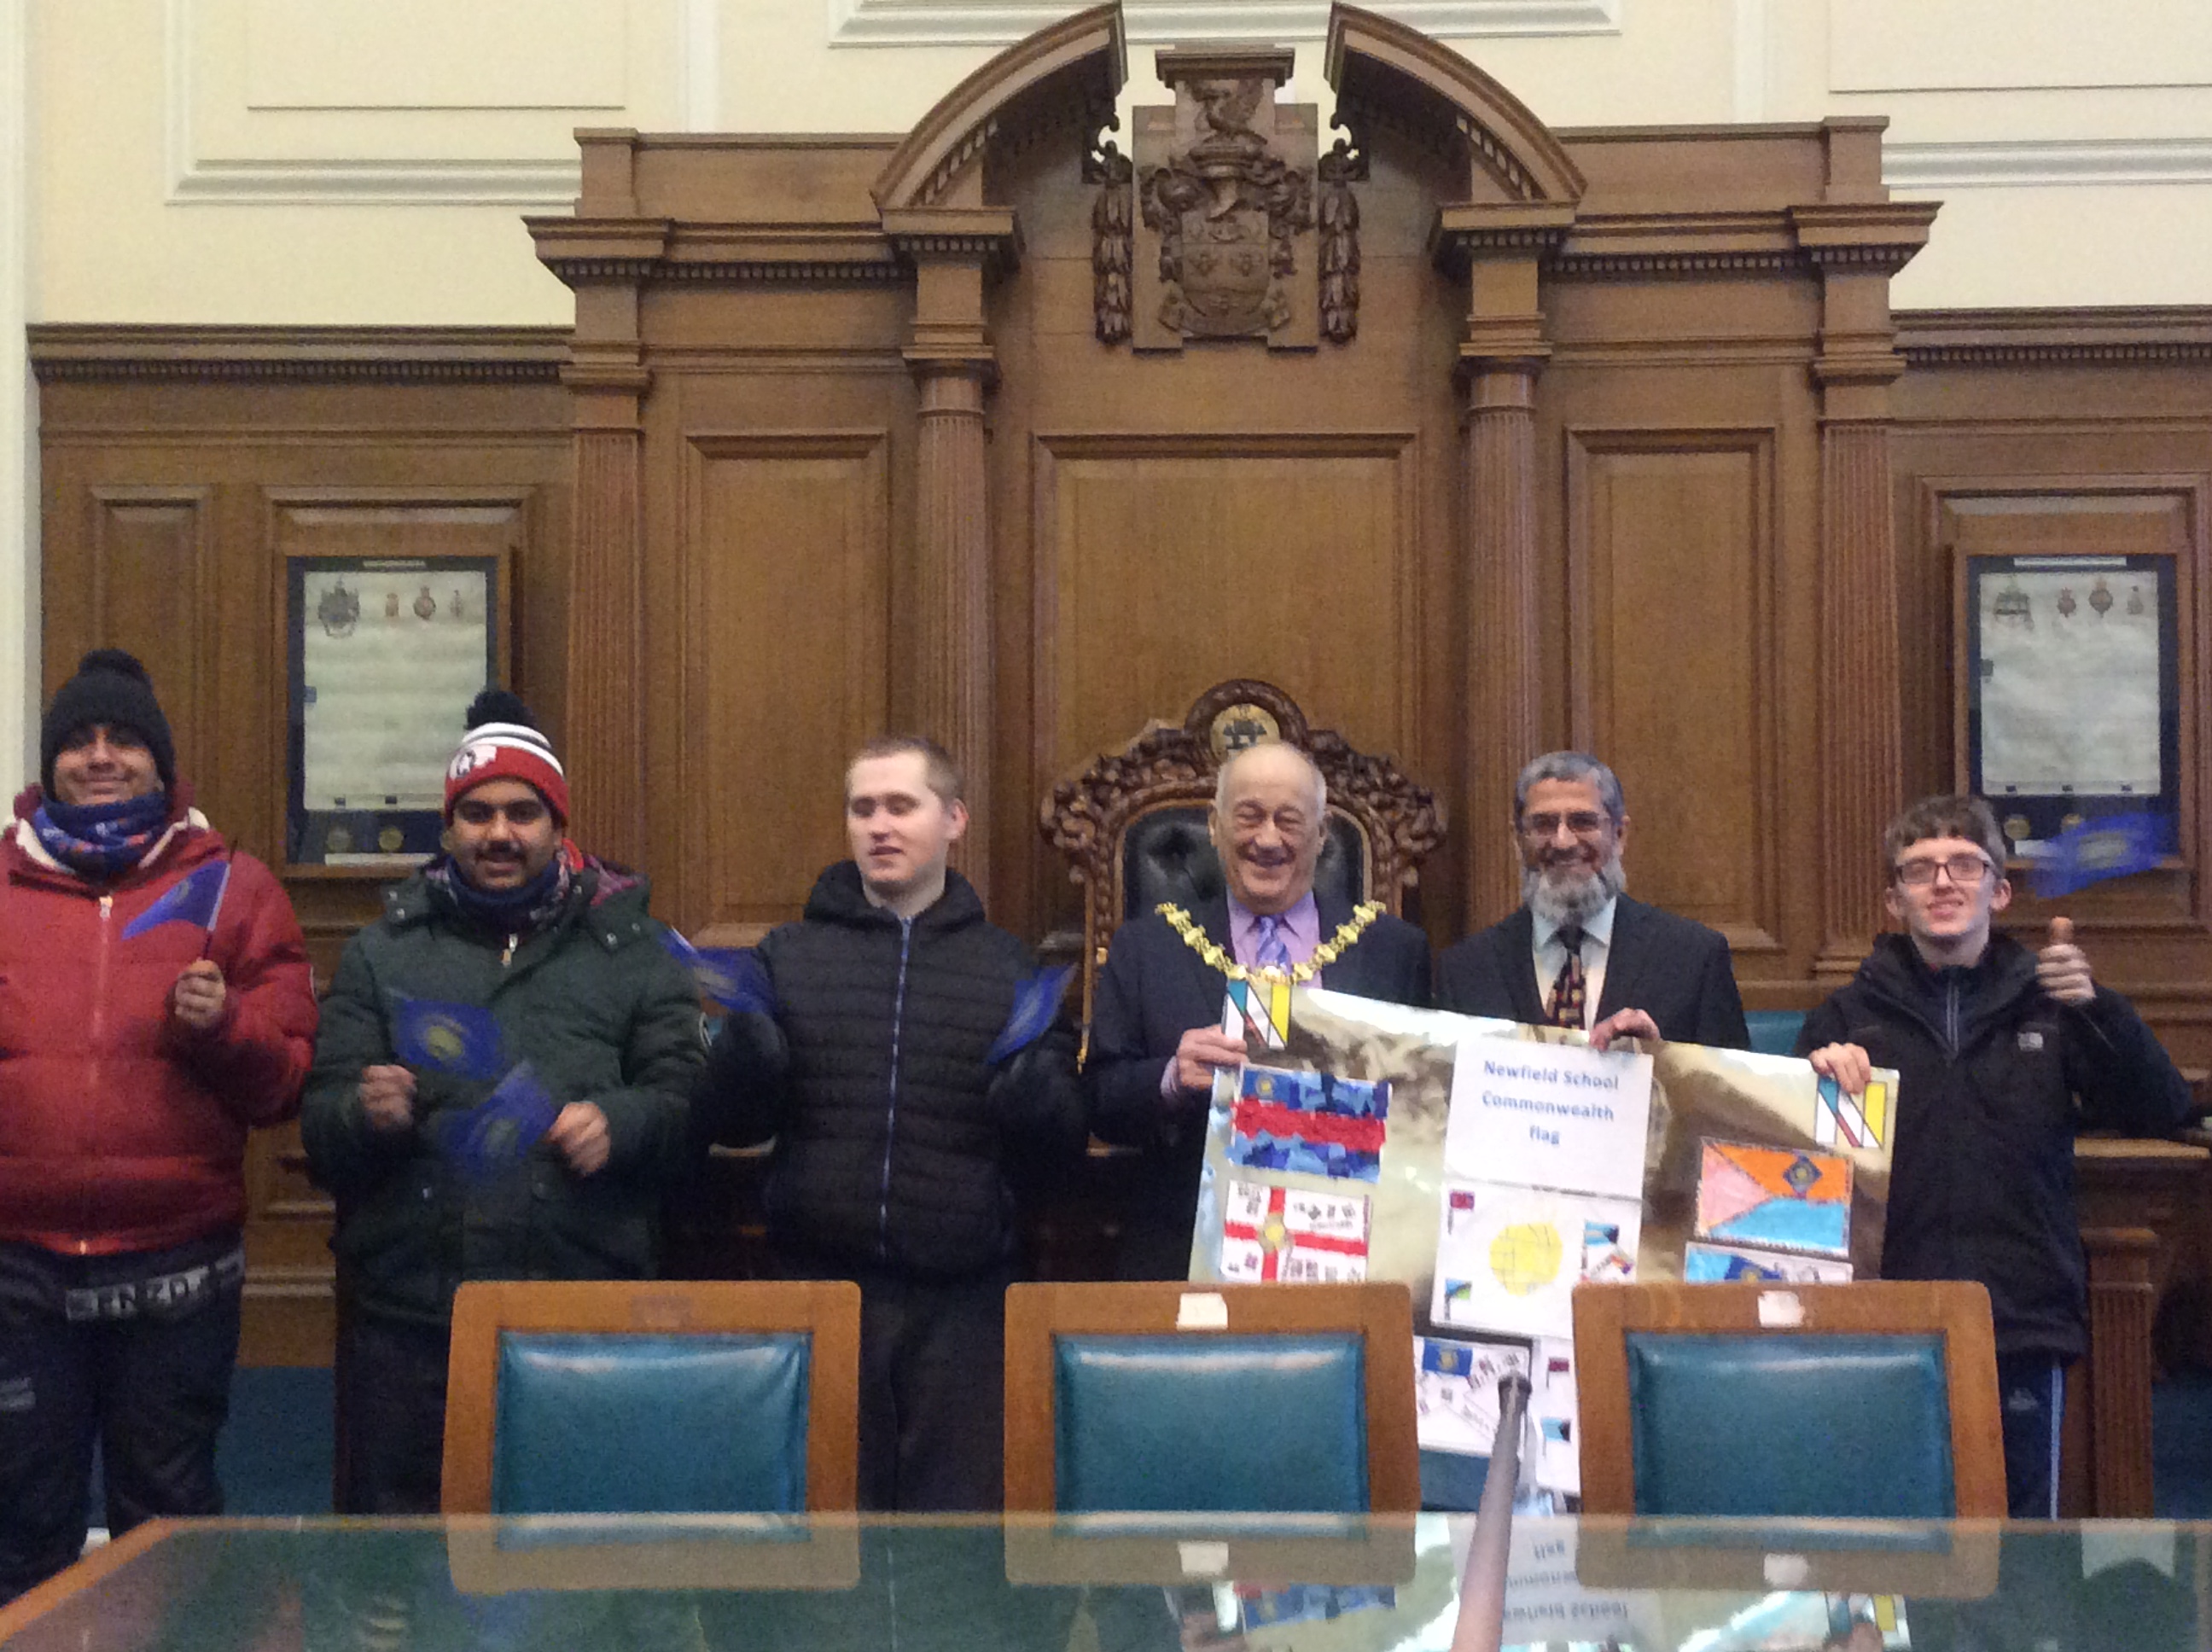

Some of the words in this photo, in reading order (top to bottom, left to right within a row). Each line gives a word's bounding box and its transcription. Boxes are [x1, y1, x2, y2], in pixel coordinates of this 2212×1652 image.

[1483, 1061, 1557, 1084] Newfield
[1563, 1069, 1618, 1090] School
[1481, 1091, 1615, 1120] Commonwealth
